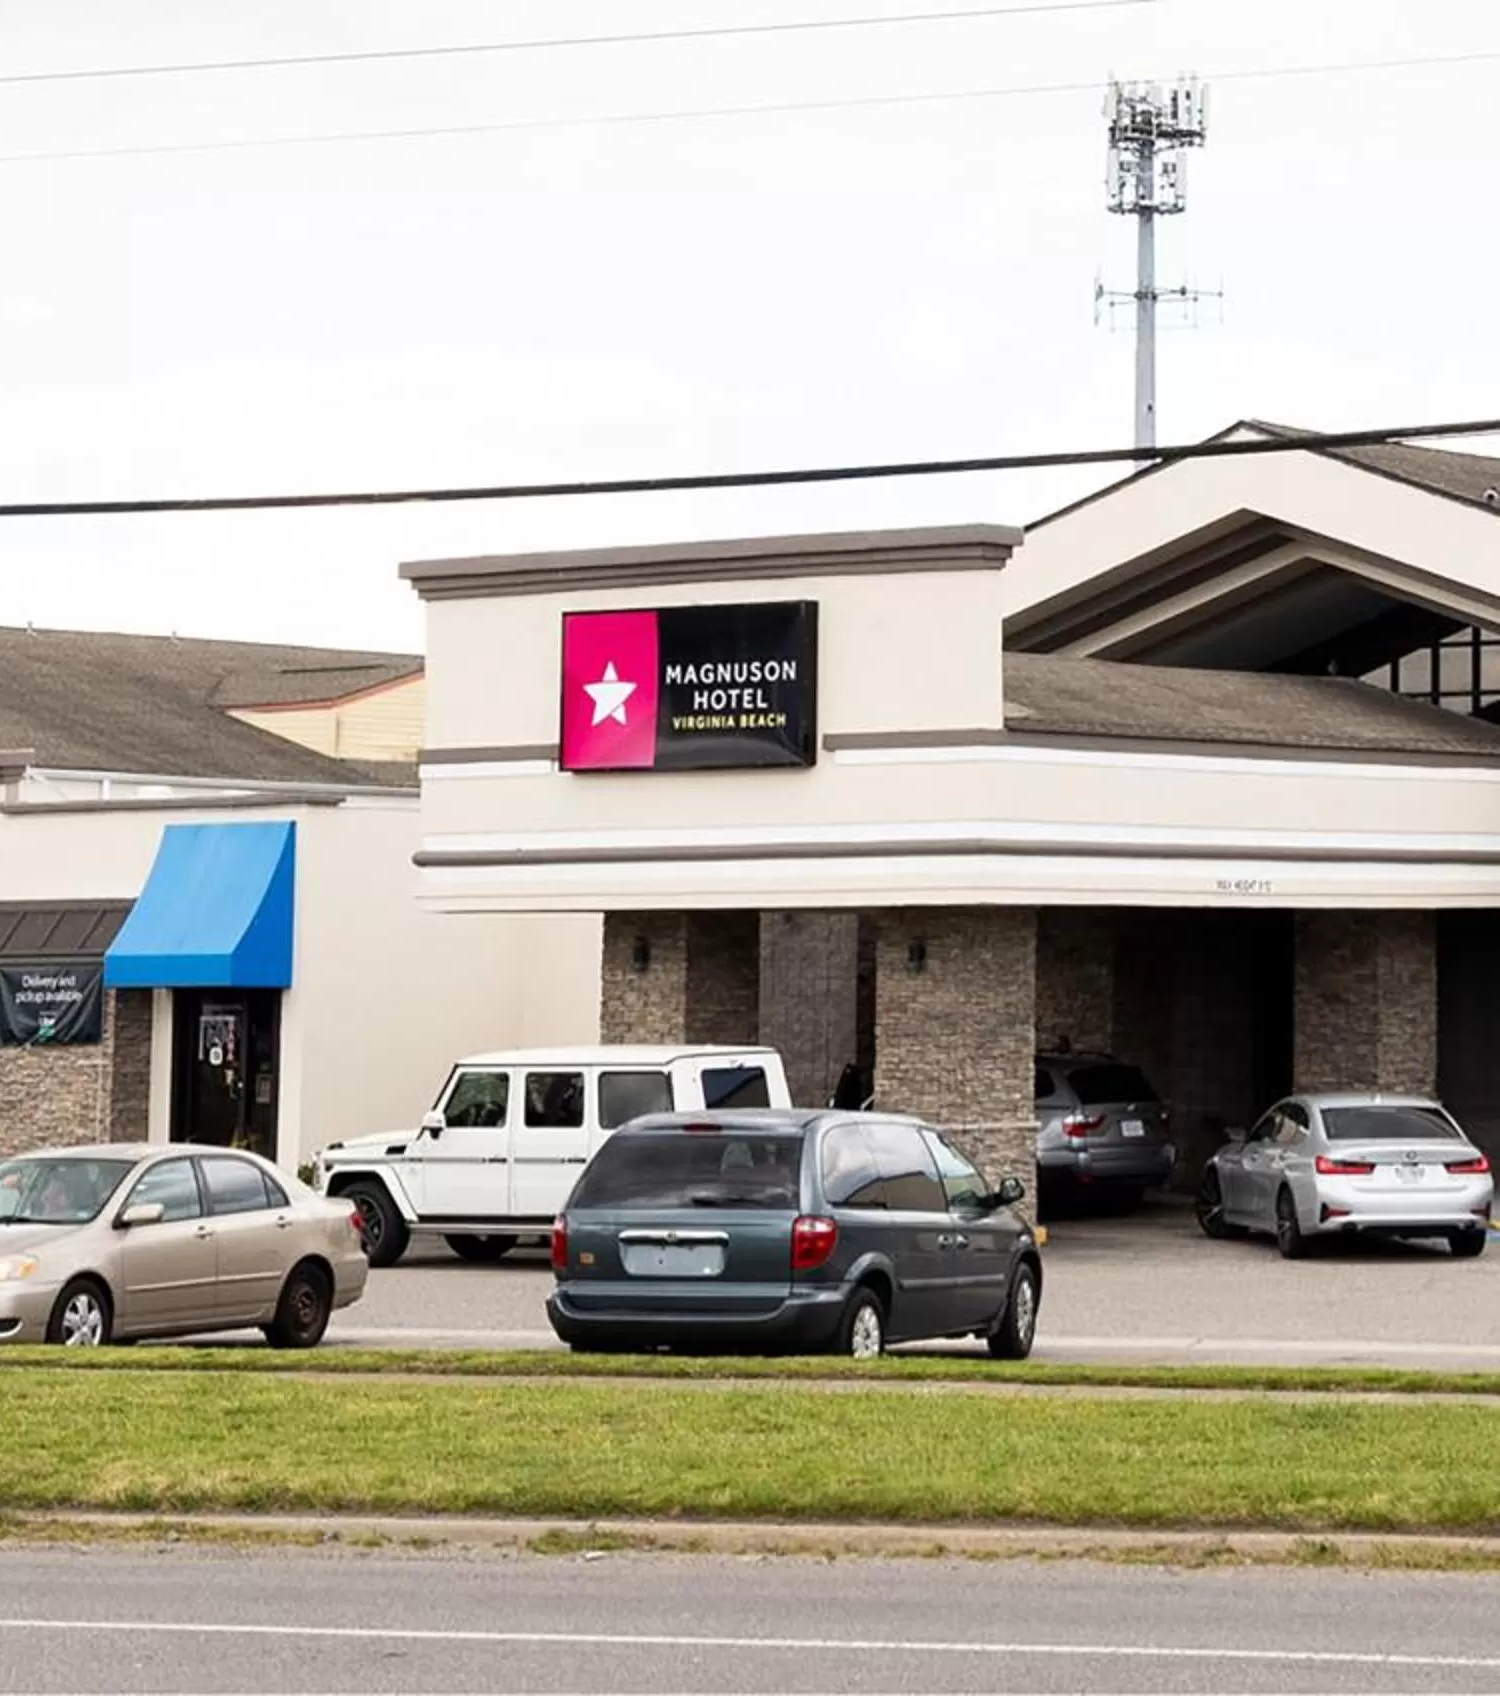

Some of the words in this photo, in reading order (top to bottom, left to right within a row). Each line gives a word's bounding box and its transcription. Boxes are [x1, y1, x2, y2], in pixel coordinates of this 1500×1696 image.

[665, 660, 797, 684] MAGNUSON
[693, 688, 768, 710] HOTEL
[672, 714, 735, 730] VIRGINIA
[739, 713, 787, 729] BEACH
